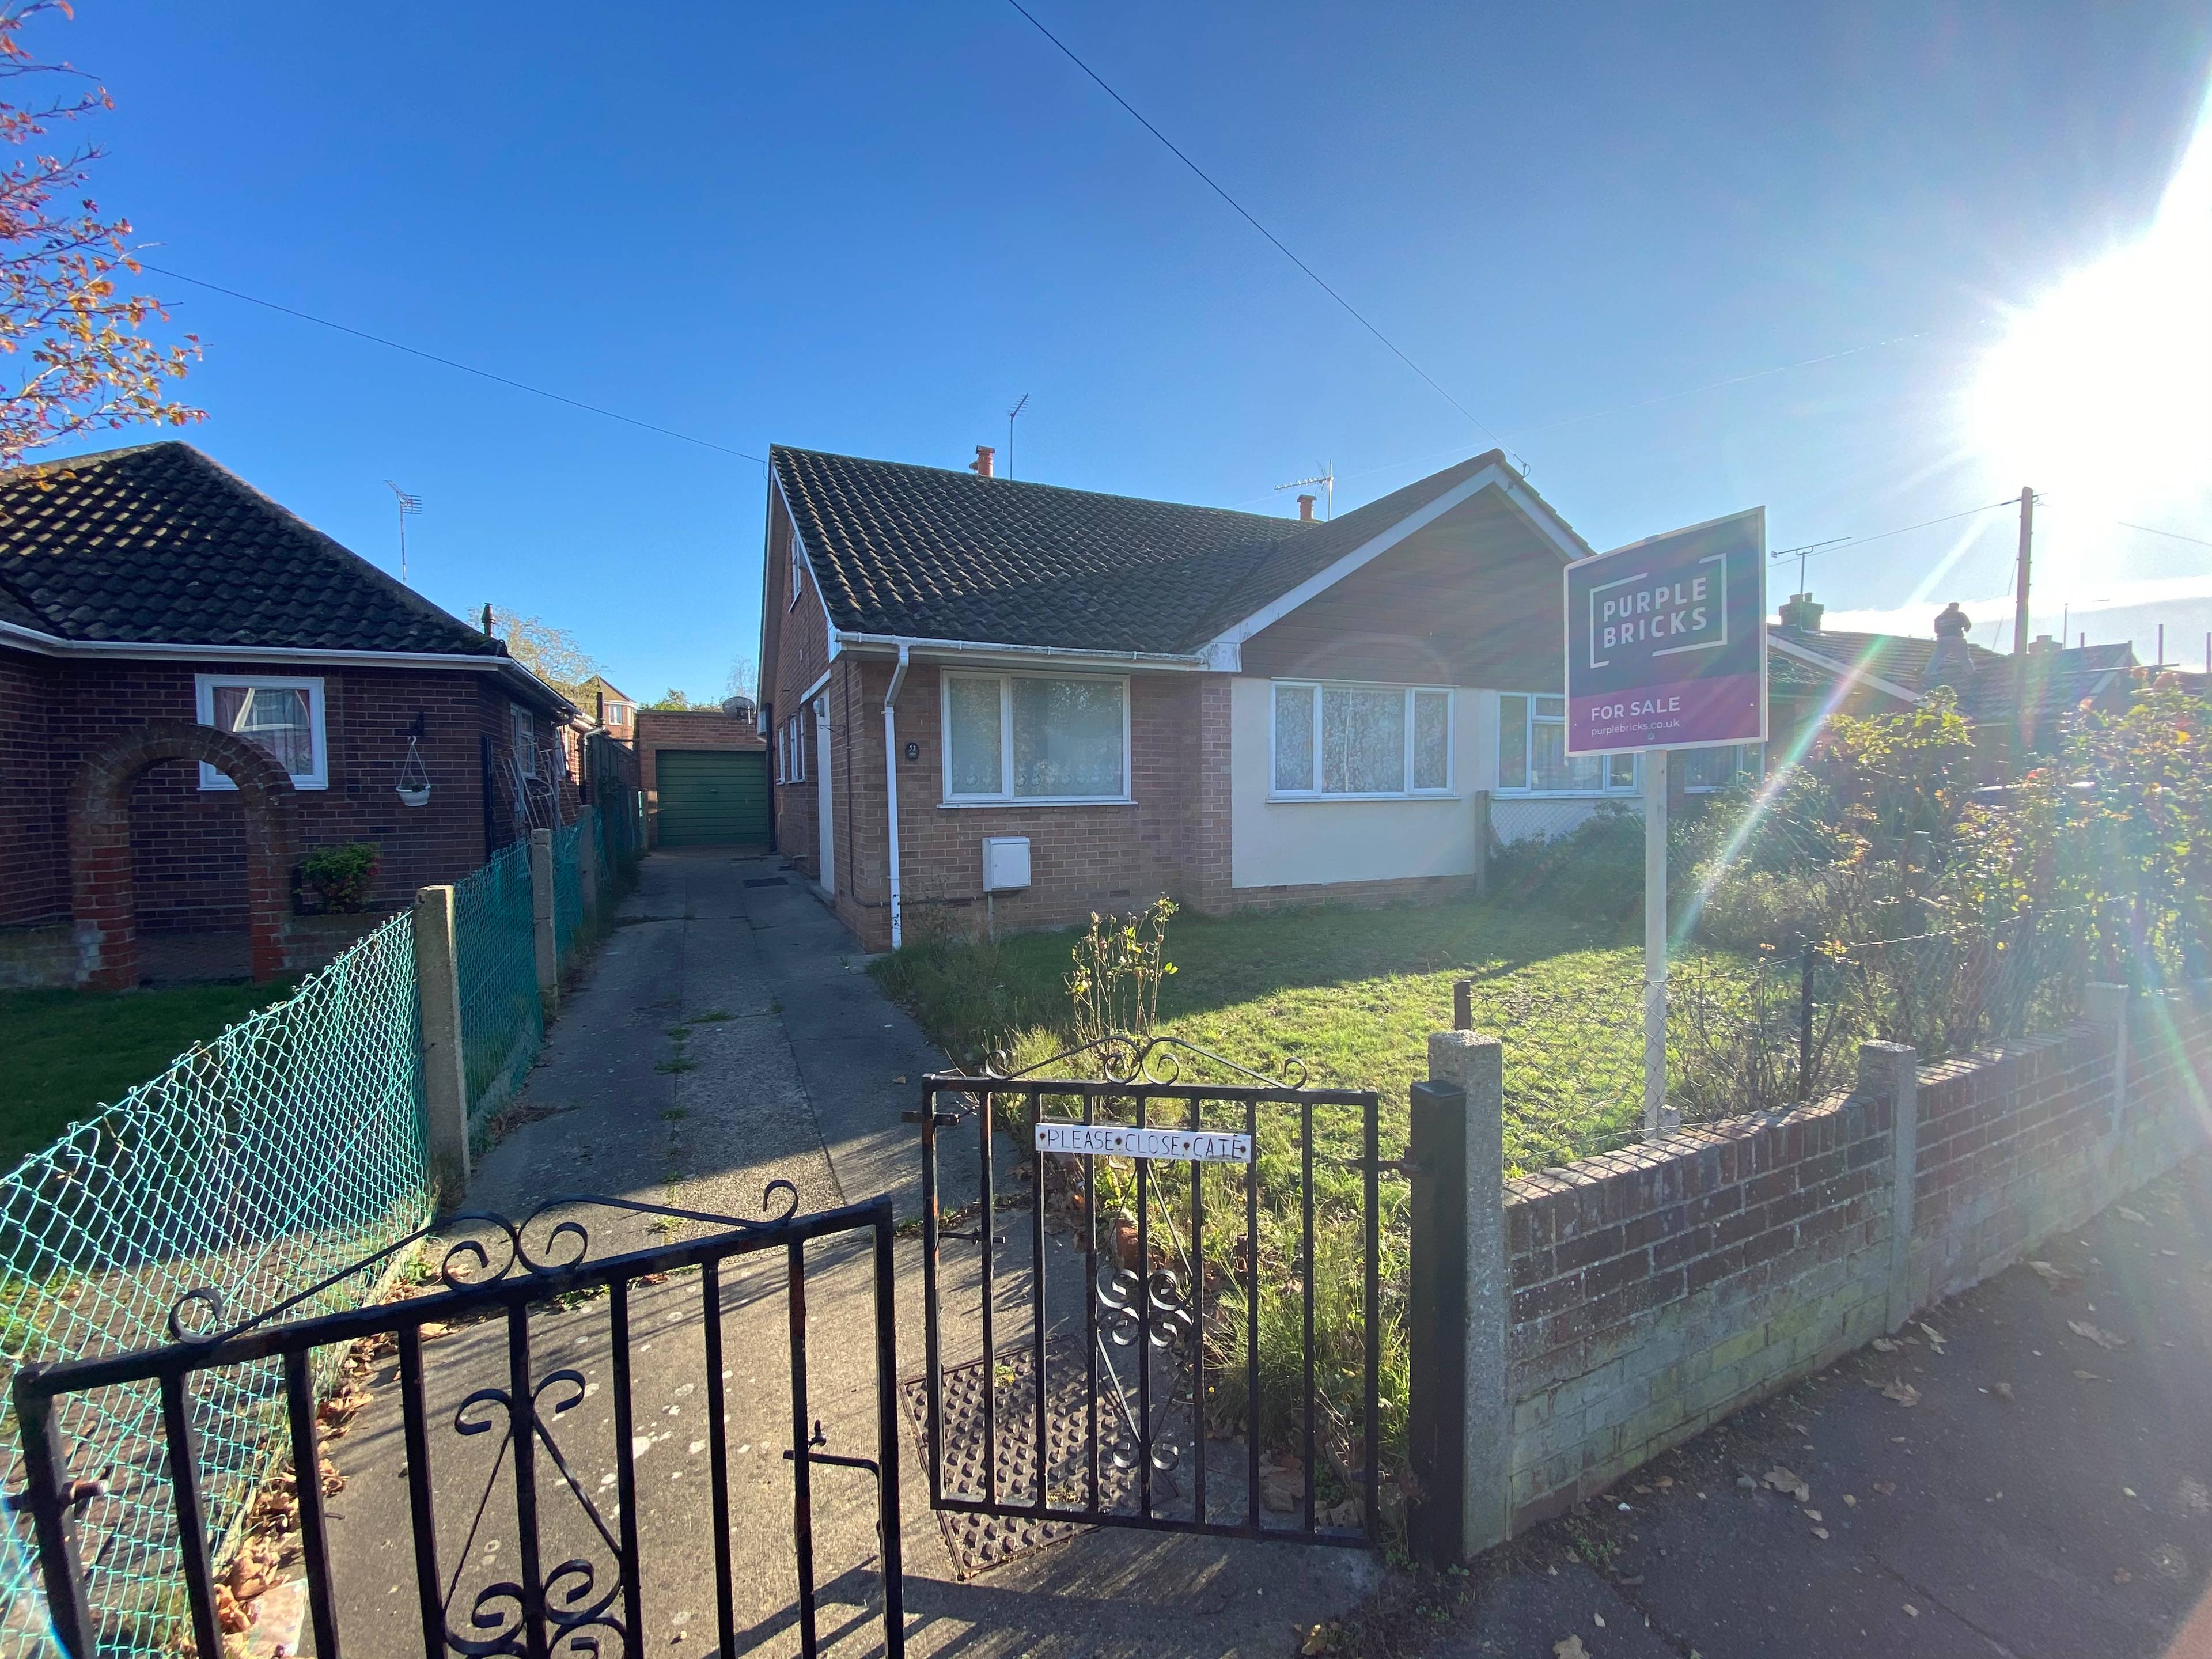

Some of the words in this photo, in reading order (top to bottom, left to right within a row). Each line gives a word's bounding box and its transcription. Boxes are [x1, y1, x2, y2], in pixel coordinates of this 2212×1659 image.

[1603, 577, 1707, 623] PURPLE
[1603, 607, 1707, 649] BRICKS
[1591, 704, 1624, 721] FOR
[1630, 696, 1681, 716] SALE
[1591, 718, 1681, 737] purplebricks.co.uk
[1048, 1129, 1114, 1151] PLEASE
[1125, 1134, 1180, 1156] CLOSE
